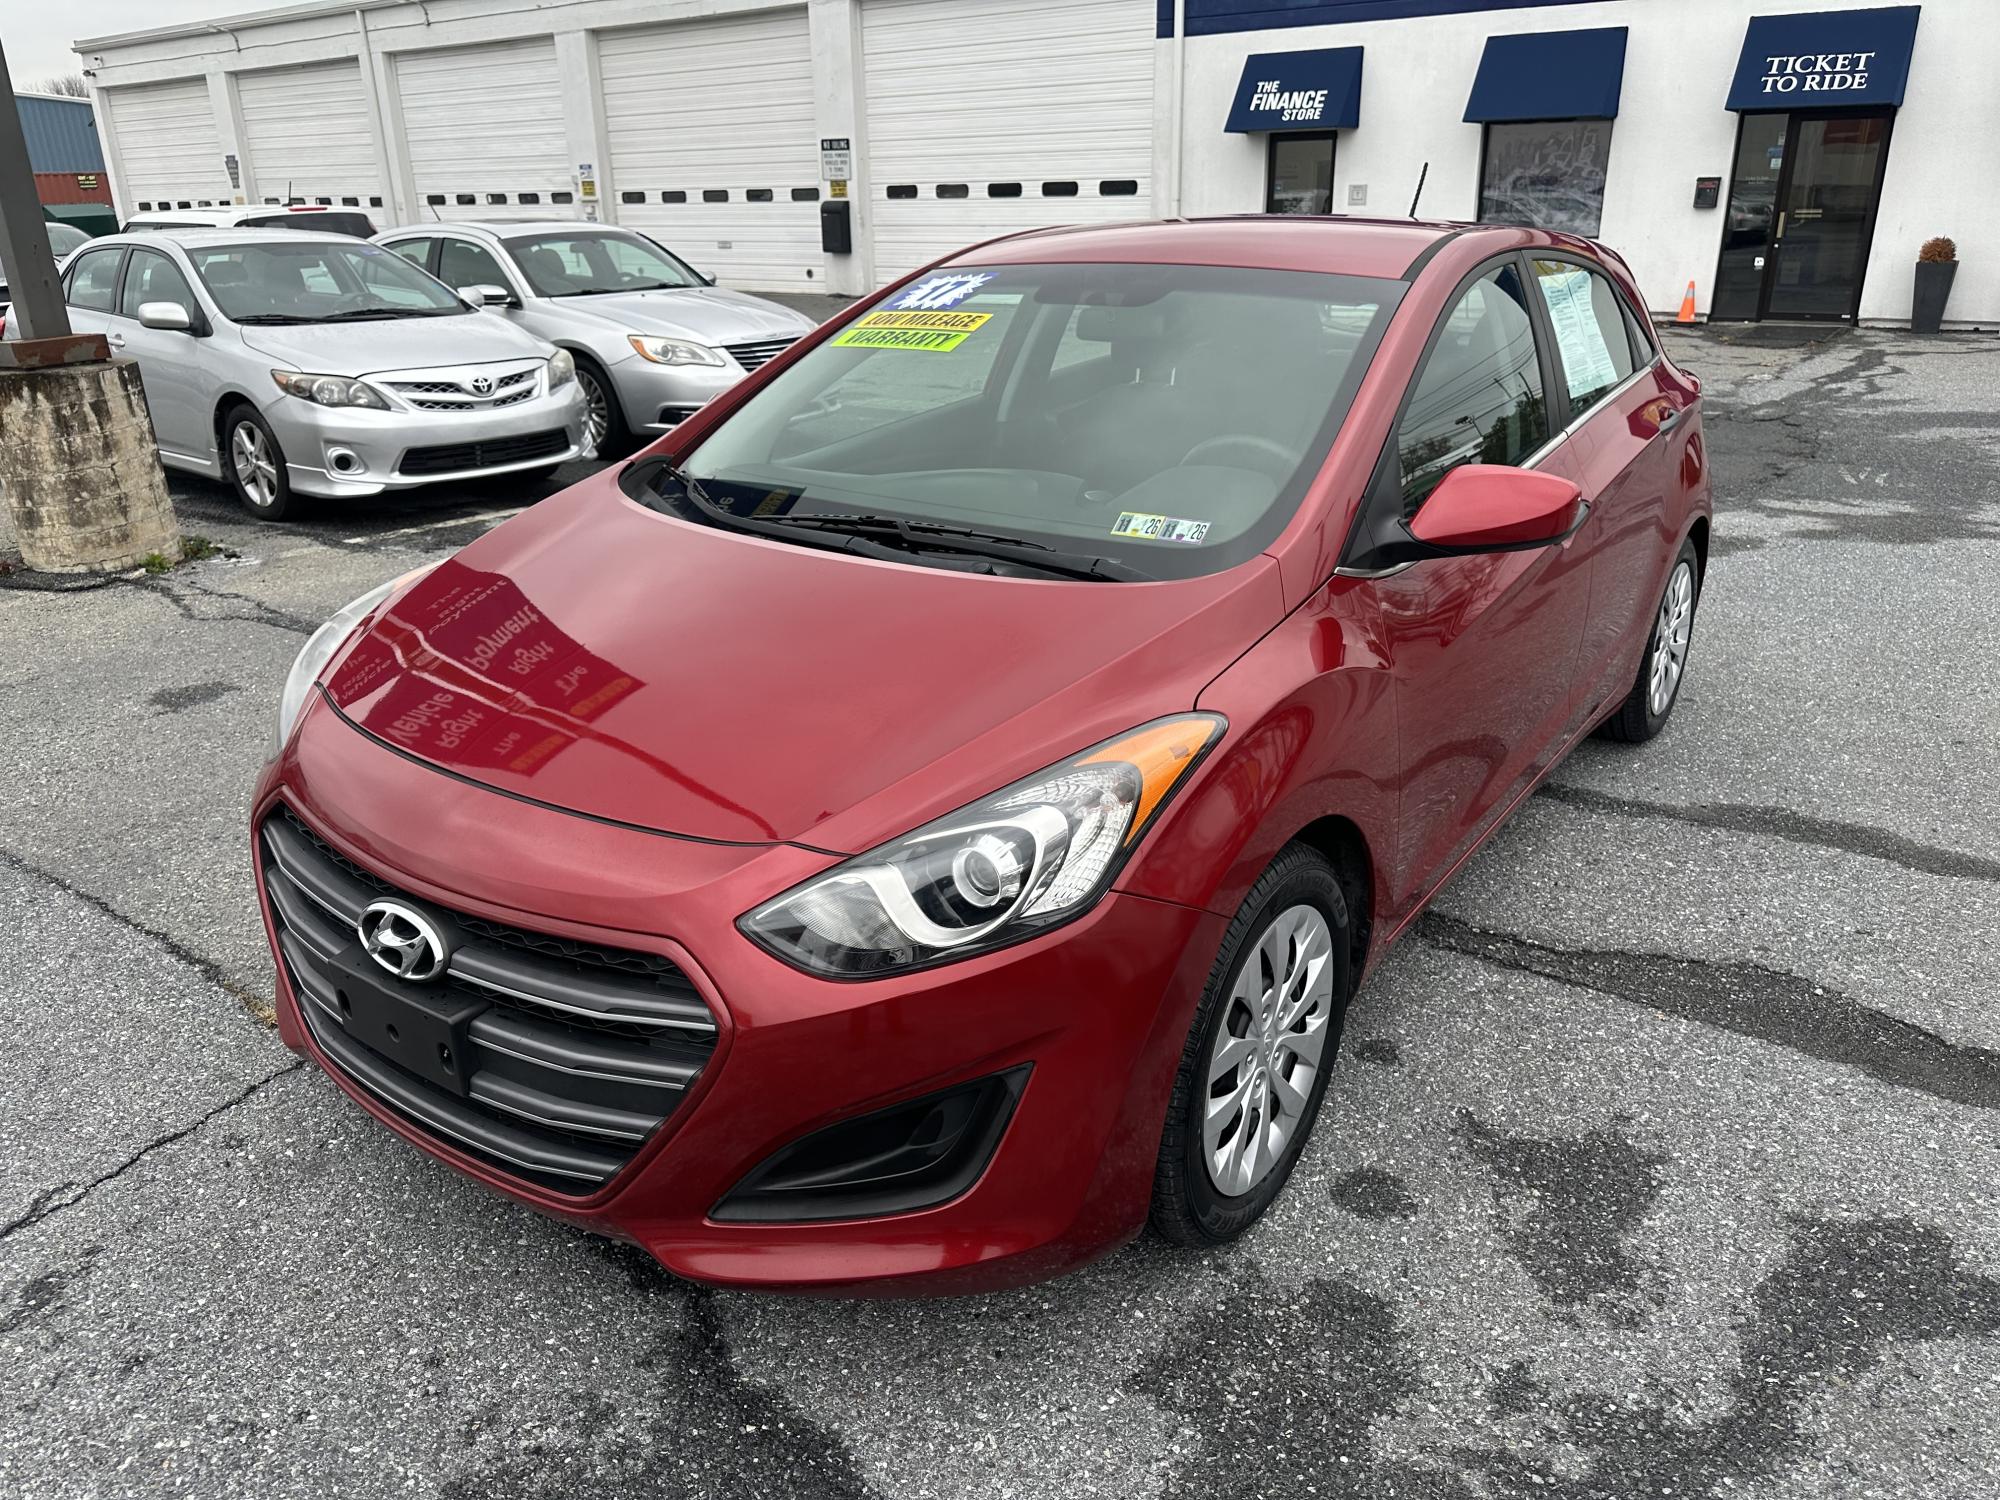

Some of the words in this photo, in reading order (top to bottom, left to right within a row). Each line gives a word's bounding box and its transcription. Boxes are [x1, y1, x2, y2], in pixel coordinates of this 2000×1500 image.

[1766, 51, 1876, 75] TICKET
[1257, 80, 1280, 93] THE
[1761, 75, 1798, 93] TO
[1801, 72, 1869, 92] RIDE
[1249, 90, 1328, 111] FINANCE
[1281, 108, 1322, 121] STORE
[864, 313, 900, 327] LOW
[901, 313, 985, 329] MILEAGE
[845, 330, 961, 347] WARRANTY
[1117, 518, 1132, 532] 11
[1145, 518, 1161, 534] 26
[1162, 523, 1177, 538] 11
[1190, 524, 1207, 540] 26
